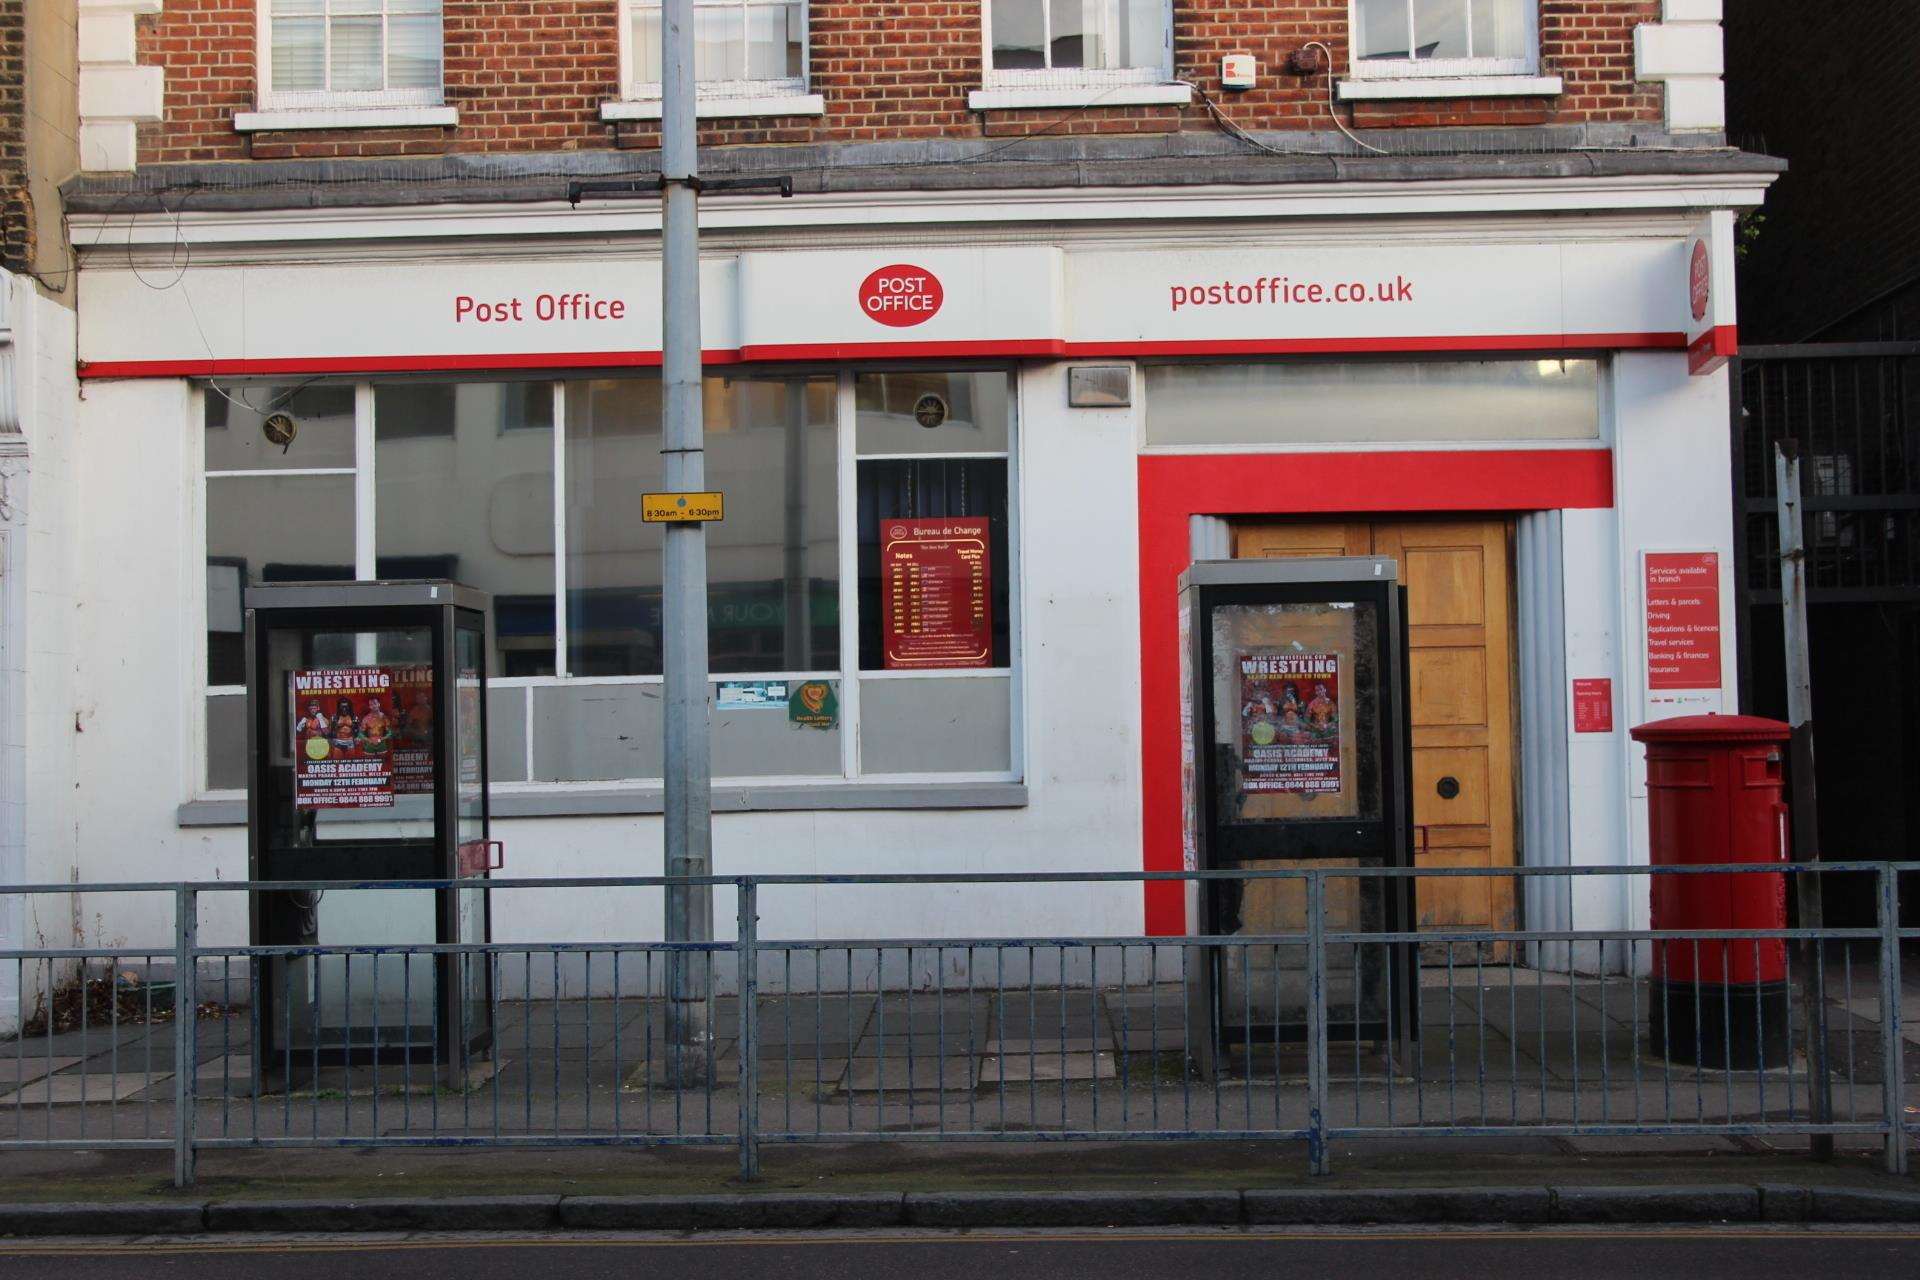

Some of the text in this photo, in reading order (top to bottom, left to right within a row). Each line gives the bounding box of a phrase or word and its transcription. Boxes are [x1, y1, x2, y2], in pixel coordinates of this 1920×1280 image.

[878, 277, 926, 293] POST
[1170, 275, 1413, 311] postoffice.co.uk
[456, 293, 626, 323] Post Office
[867, 295, 934, 311] OFFICE
[913, 527, 941, 536] Bureau
[943, 527, 952, 536] de
[954, 526, 982, 536] Change
[1649, 566, 1707, 575] Services available
[1649, 575, 1681, 583] in branch
[1678, 598, 1701, 607] parcels
[1648, 612, 1670, 620] Driving
[1648, 625, 1685, 633] Applications
[1648, 651, 1709, 660] Banking & finances
[1241, 659, 1336, 674] WRESTLING
[296, 674, 390, 690] WRESTLING
[393, 752, 428, 762] CADEMY
[1253, 747, 1329, 759] OASIS ACADEMY
[307, 764, 337, 774] OASIS
[338, 762, 384, 773] ACADEMY
[1248, 762, 1334, 772] MONDAY 12TH FEBRUARY
[302, 776, 387, 788] MONDAY 12TH FEBRUARY
[1243, 781, 1259, 790] BOX
[297, 796, 312, 805] BOX
[313, 796, 339, 804] OFFICE:
[339, 795, 358, 804] 0844
